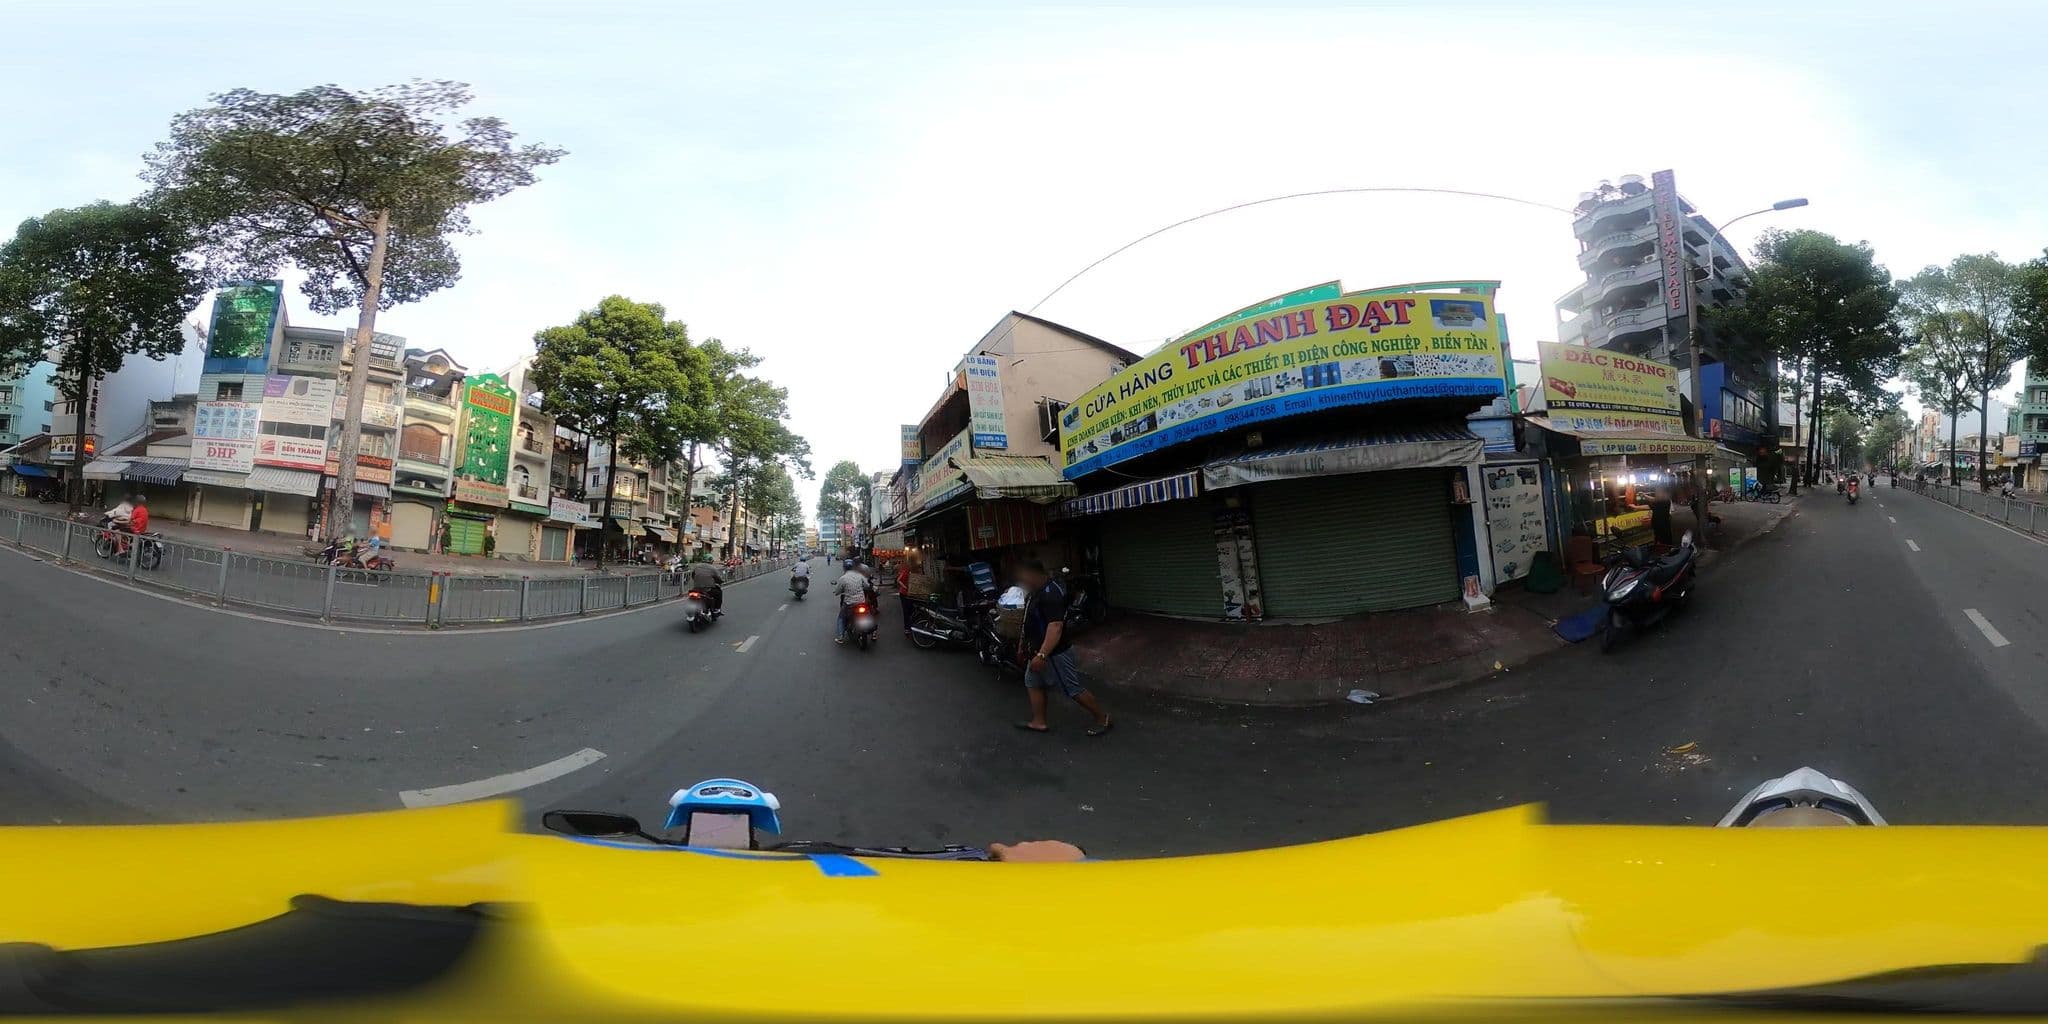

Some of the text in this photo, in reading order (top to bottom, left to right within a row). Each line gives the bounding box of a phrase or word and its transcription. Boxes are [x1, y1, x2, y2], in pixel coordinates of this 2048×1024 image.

[1180, 298, 1416, 369] THANH ĐẠT
[1085, 362, 1173, 418] CỬA HÀNG
[1187, 377, 1206, 395] LỰC
[1207, 369, 1220, 387] VÀ
[1222, 364, 1243, 382] CÁC
[1244, 352, 1279, 376] THIẾT
[1283, 352, 1296, 369] BỊ
[1298, 343, 1329, 364] ĐIỆN
[1332, 339, 1368, 357] CÔNG
[1372, 334, 1421, 354] NGHIỆP
[1431, 331, 1462, 350] BIẾN
[1612, 356, 1667, 378] HOÀNG
[207, 446, 237, 459] ĐHP
